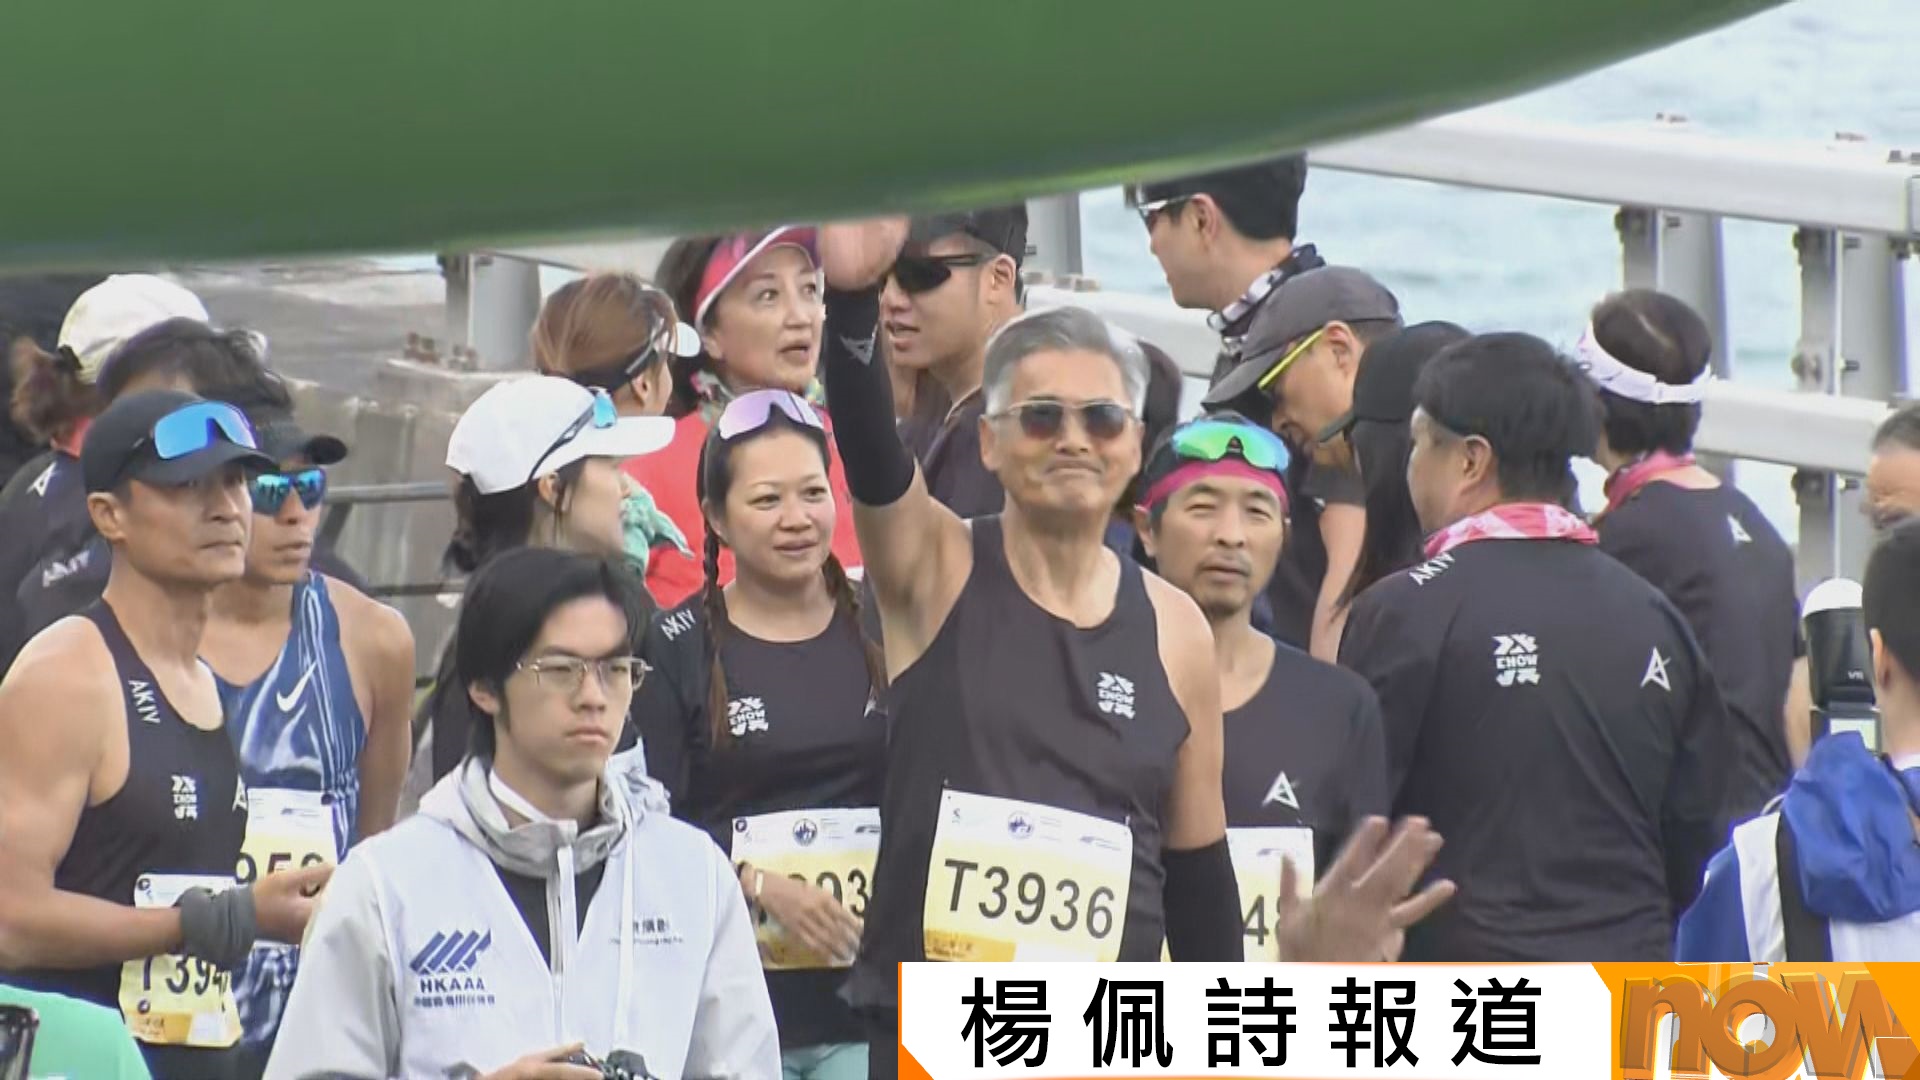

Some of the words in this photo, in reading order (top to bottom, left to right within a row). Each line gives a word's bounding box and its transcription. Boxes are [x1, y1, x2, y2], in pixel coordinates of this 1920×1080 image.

[1409, 551, 1455, 585] AKIV
[661, 608, 696, 641] AKIV
[128, 680, 160, 723] AKIV
[944, 858, 1114, 939] T3936
[420, 977, 484, 993] HKAAA
